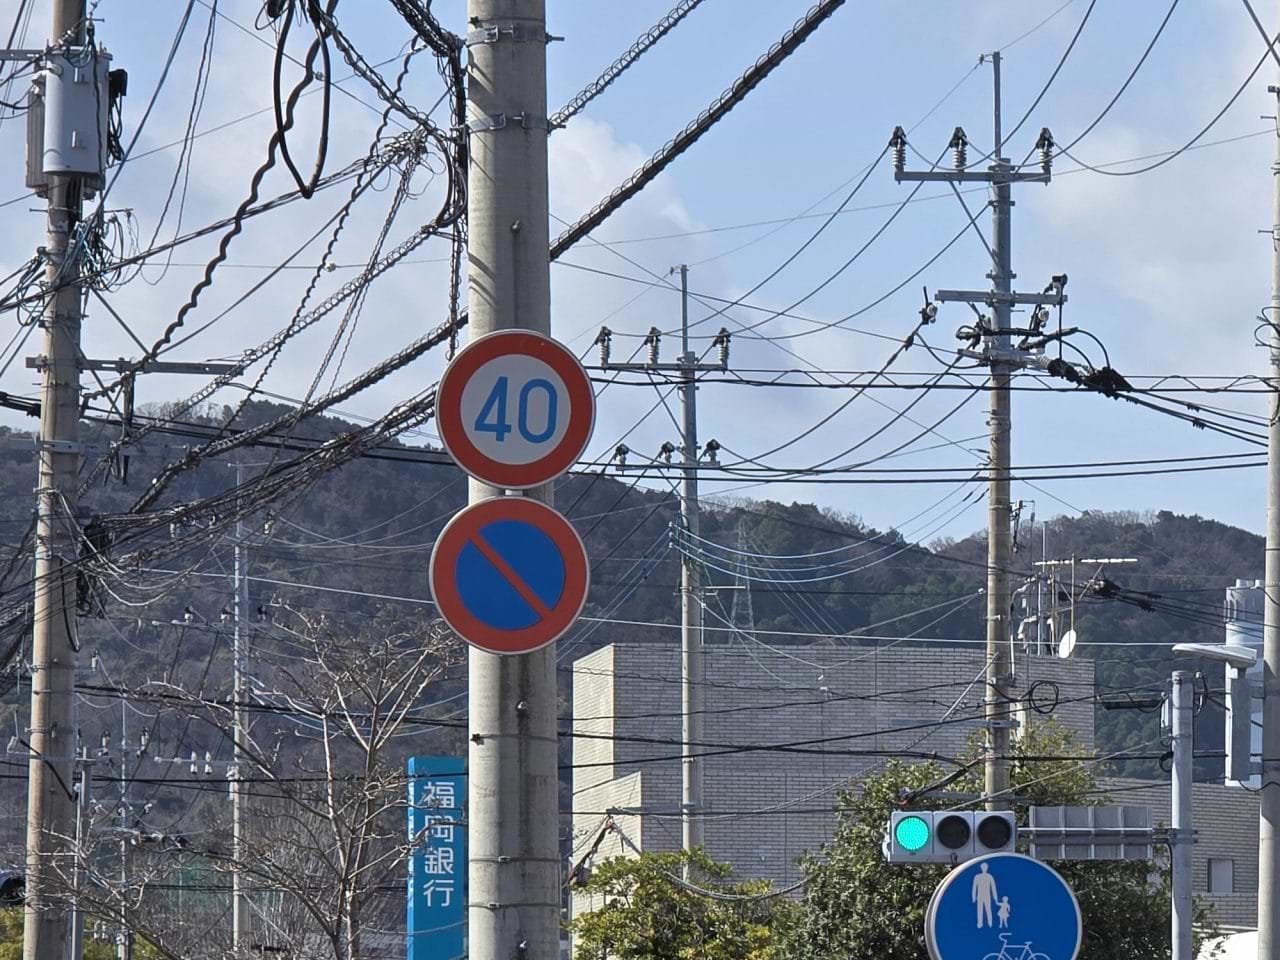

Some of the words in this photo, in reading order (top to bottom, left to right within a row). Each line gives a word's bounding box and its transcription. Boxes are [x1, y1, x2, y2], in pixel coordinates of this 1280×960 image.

[474, 376, 558, 443] 40
[423, 781, 455, 907] 福岡銀行
